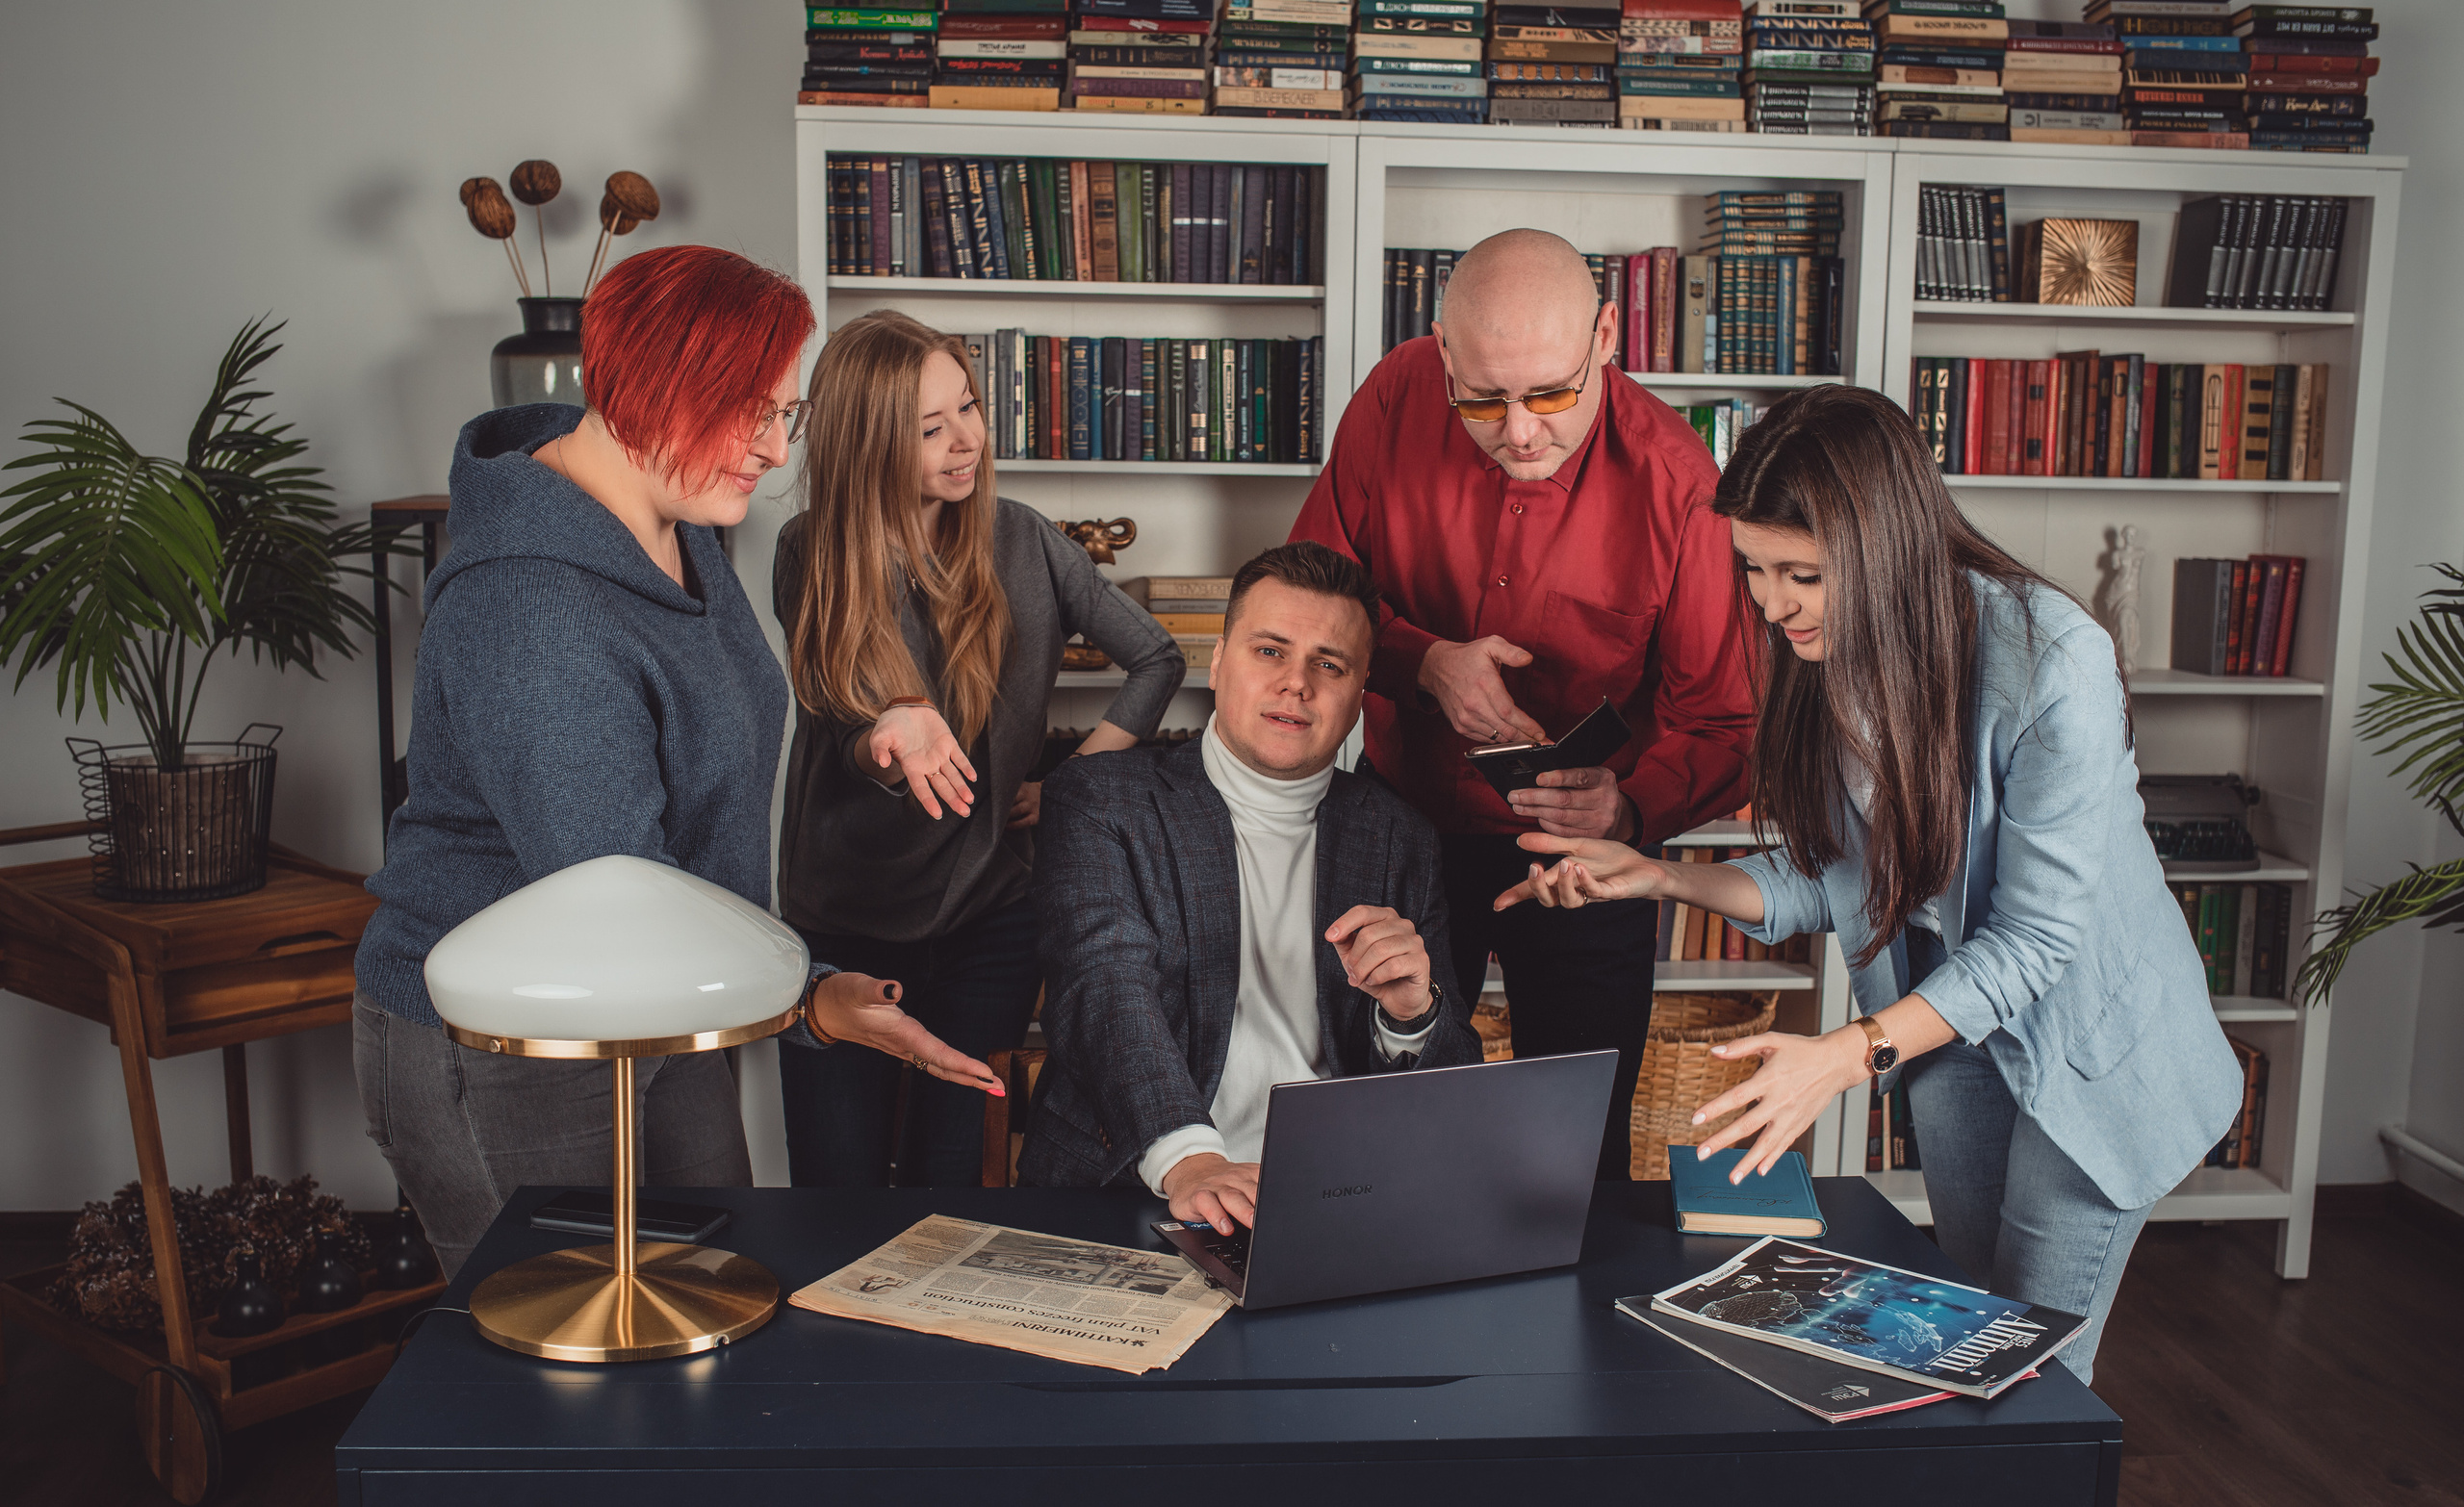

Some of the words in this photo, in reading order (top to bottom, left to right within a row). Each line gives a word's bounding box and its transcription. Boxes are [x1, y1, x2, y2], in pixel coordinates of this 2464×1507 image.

[1322, 1184, 1373, 1200] HONOR
[922, 1292, 1025, 1313] construction
[1027, 1309, 1084, 1323] freezes
[1088, 1318, 1125, 1329] plan
[1125, 1324, 1161, 1335] VAT
[1012, 1321, 1130, 1344] KATHIMERINI
[1929, 1310, 2048, 1376] Alumni
[2015, 1335, 2037, 1348] NES
[1831, 1392, 1861, 1402] РЭШ
